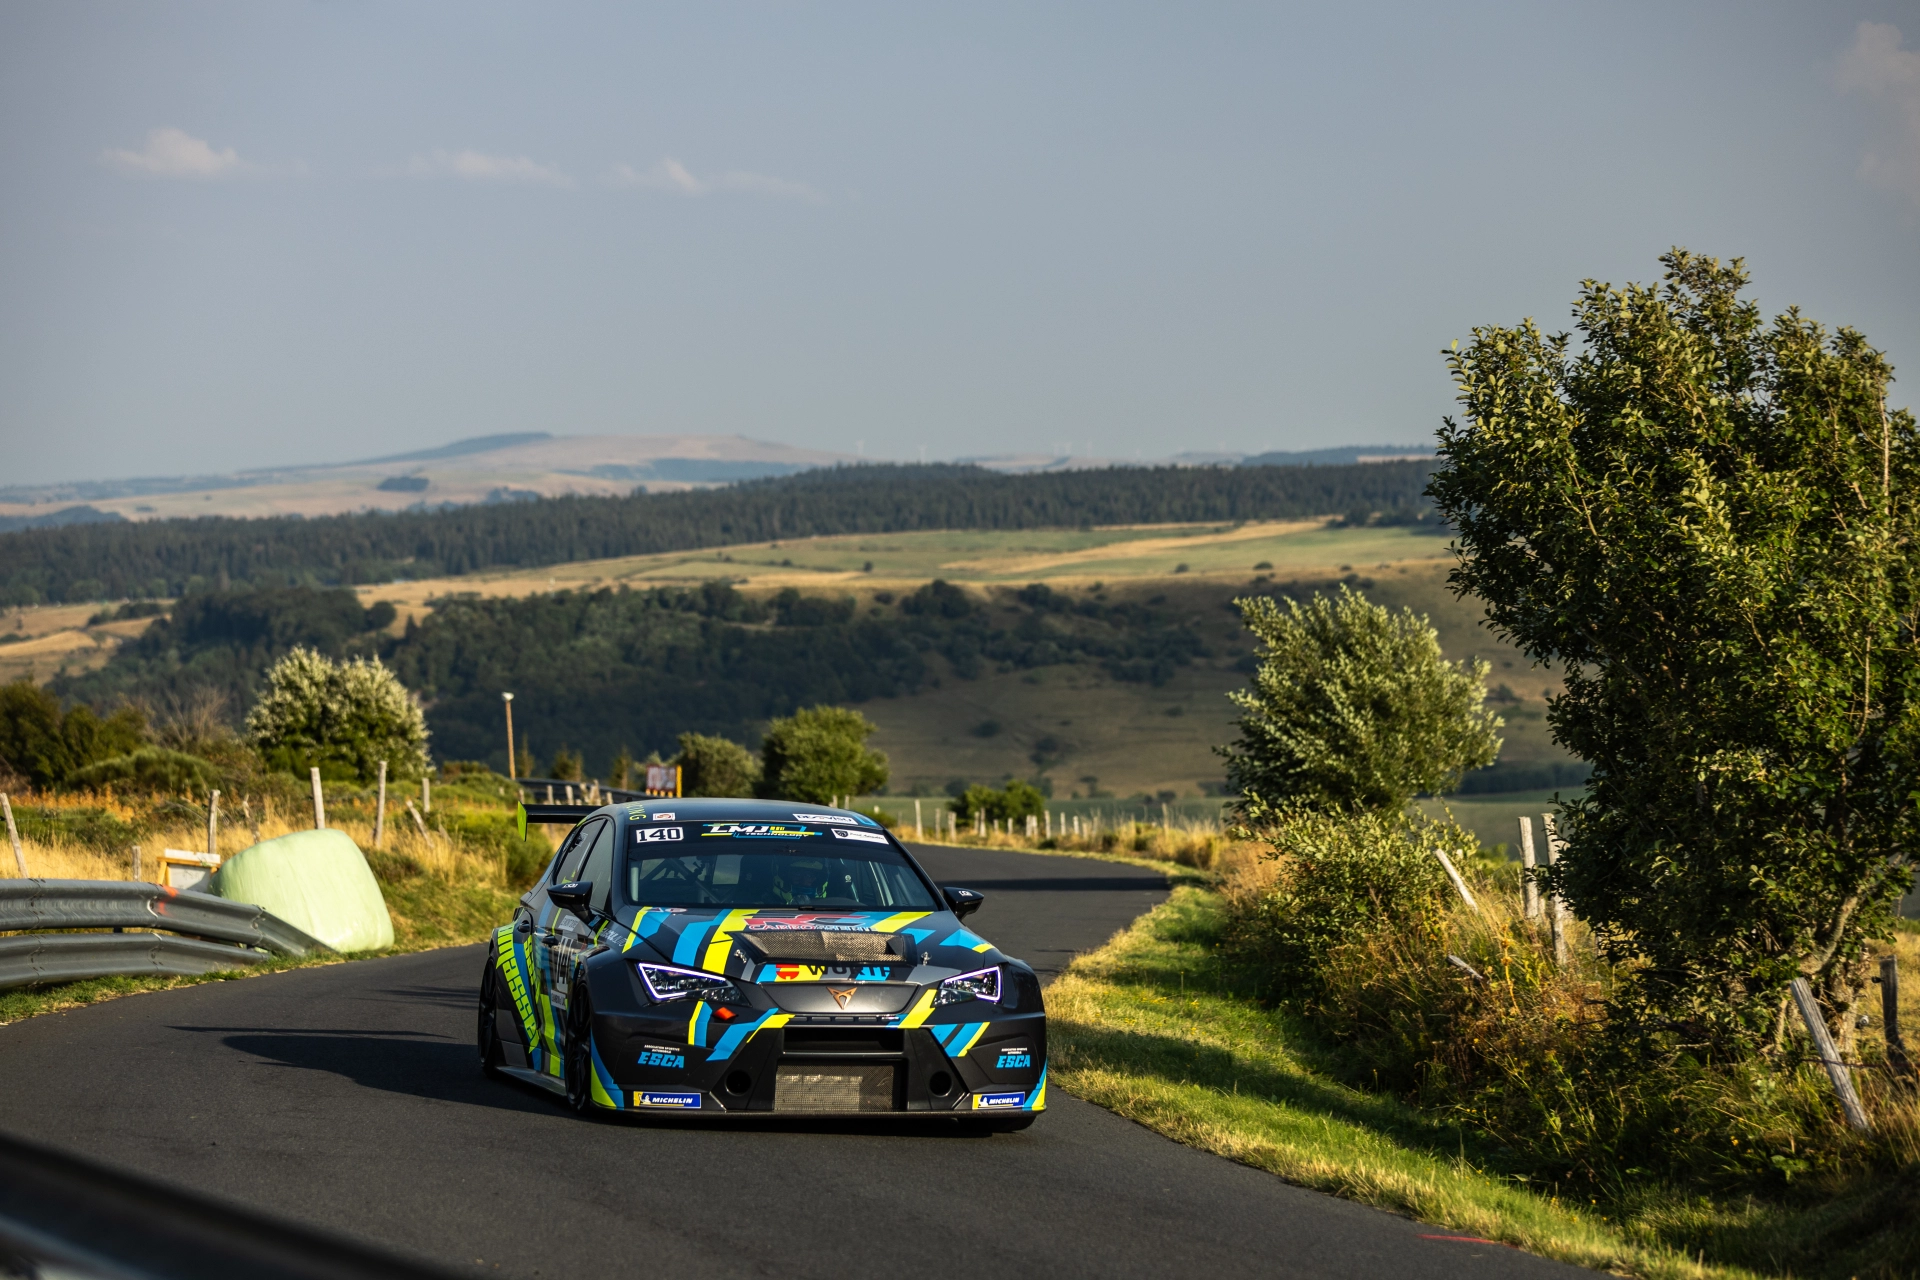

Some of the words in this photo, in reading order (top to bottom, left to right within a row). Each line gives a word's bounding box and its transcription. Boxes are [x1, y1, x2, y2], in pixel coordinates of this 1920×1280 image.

[638, 828, 681, 842] 140
[638, 1051, 684, 1068] ESCA
[996, 1055, 1030, 1068] ESCA
